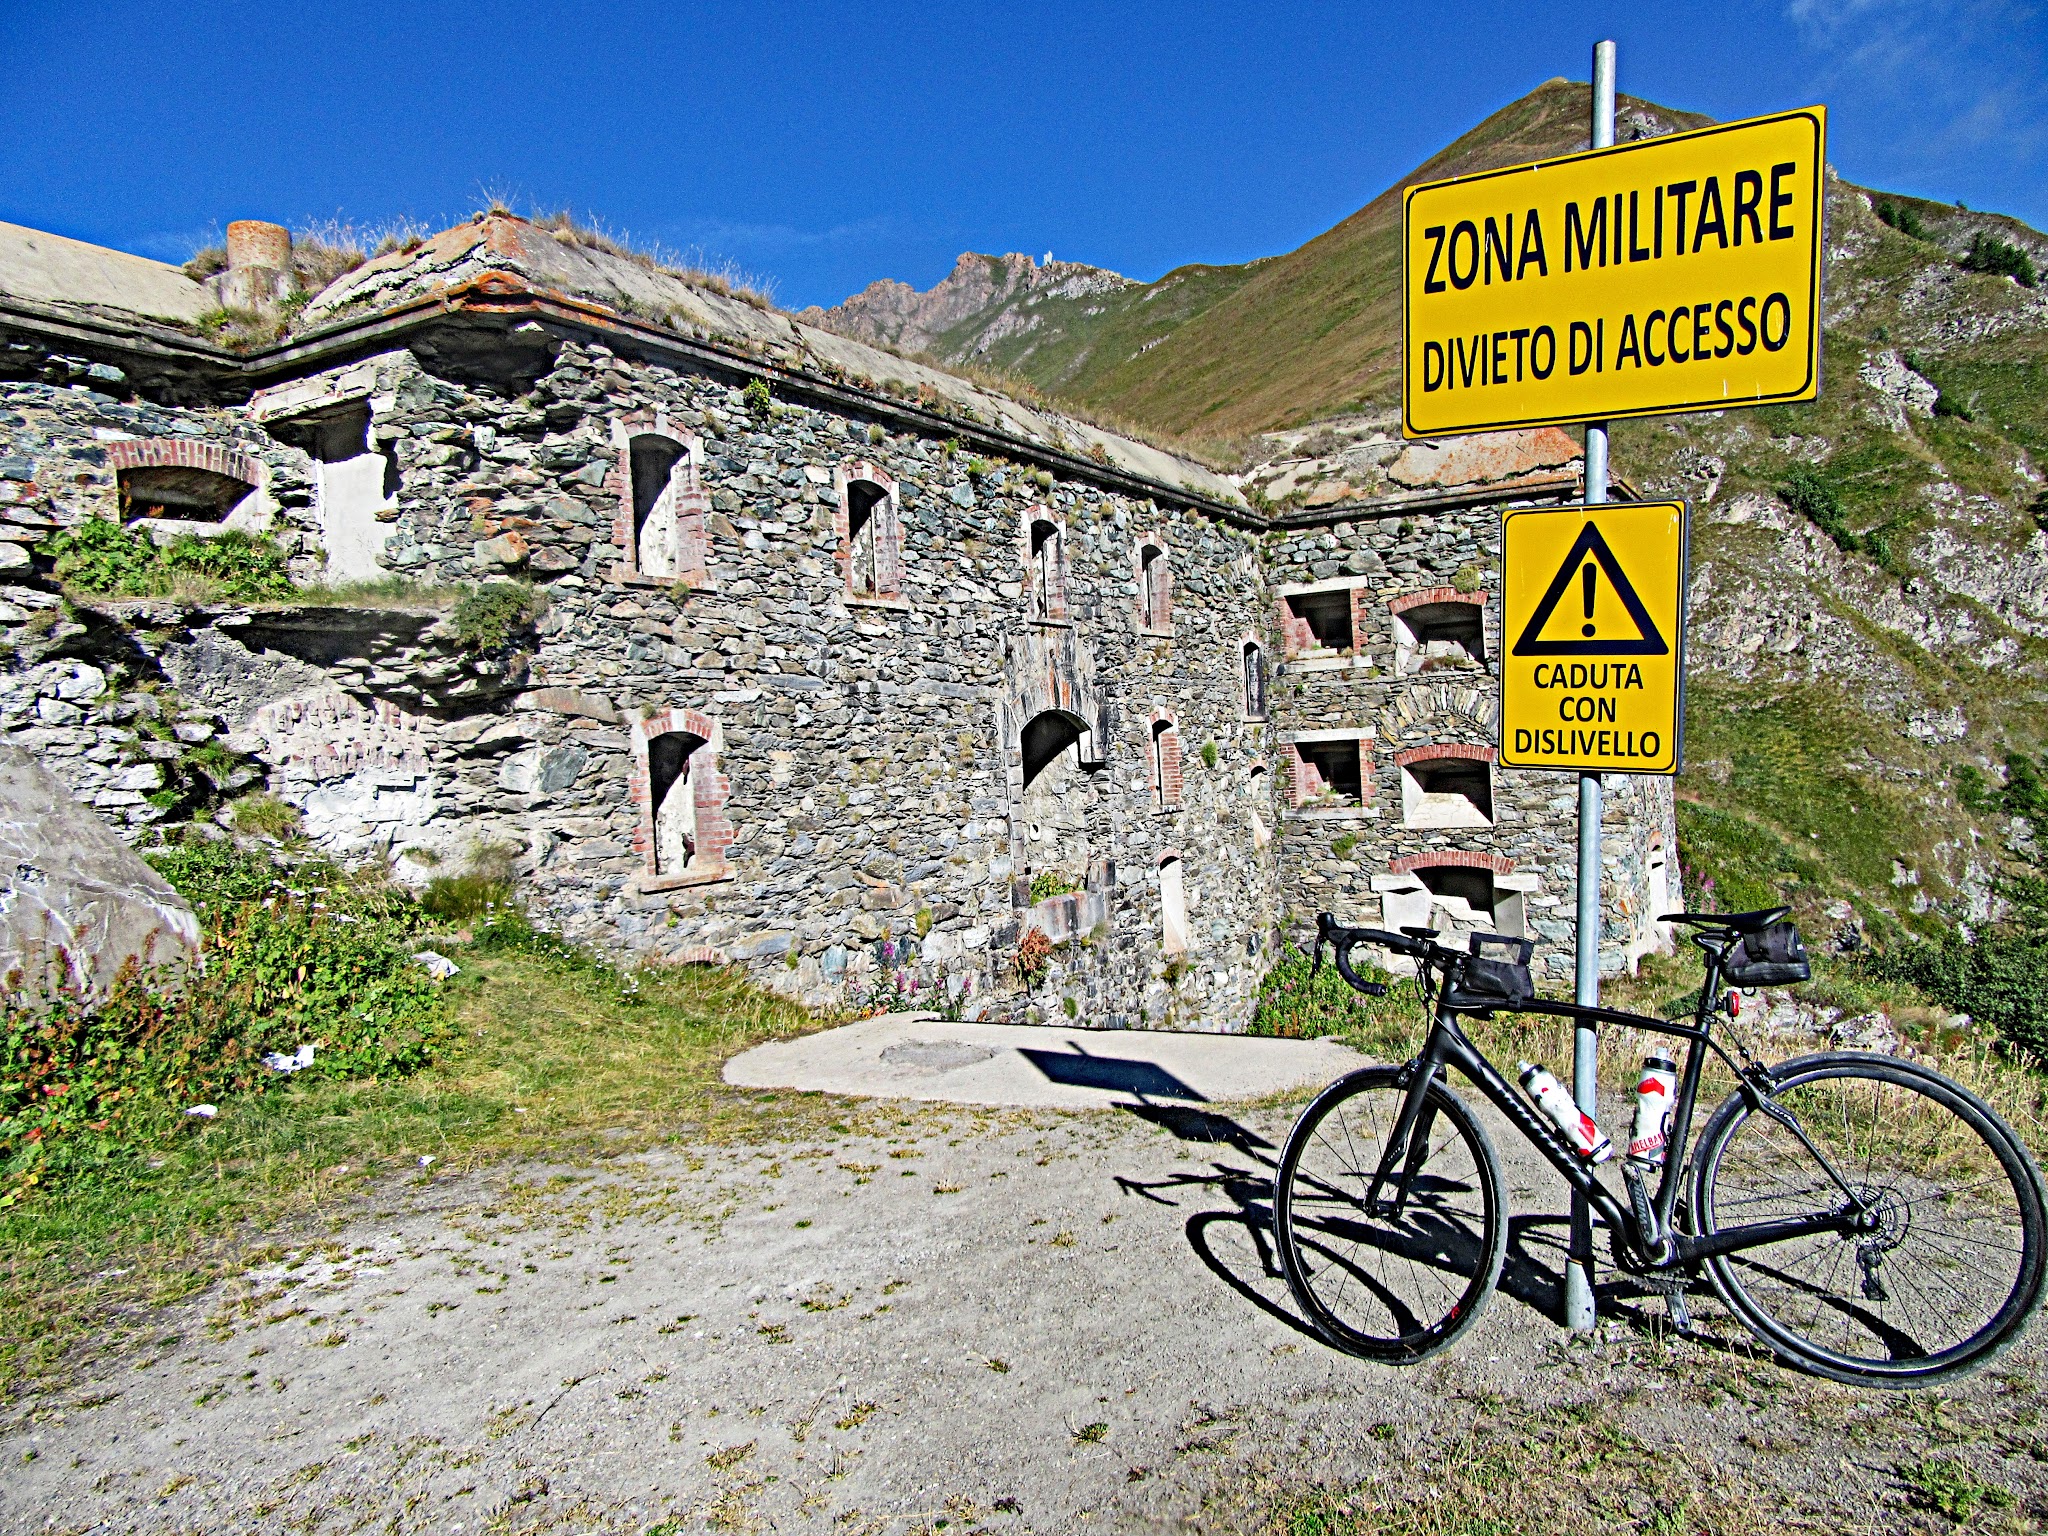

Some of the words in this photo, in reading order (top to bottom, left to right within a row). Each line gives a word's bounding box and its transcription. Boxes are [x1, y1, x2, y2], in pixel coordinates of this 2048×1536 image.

[1423, 208, 1548, 295] ZONA
[1564, 161, 1796, 273] MILITARE
[1422, 325, 1556, 393] DIVIETO
[1569, 318, 1604, 376] DI
[1615, 292, 1791, 371] ACCESSO
[1533, 663, 1644, 690] CADUTA
[1559, 696, 1616, 723] CON
[1515, 728, 1661, 758] DISLIVELLO
